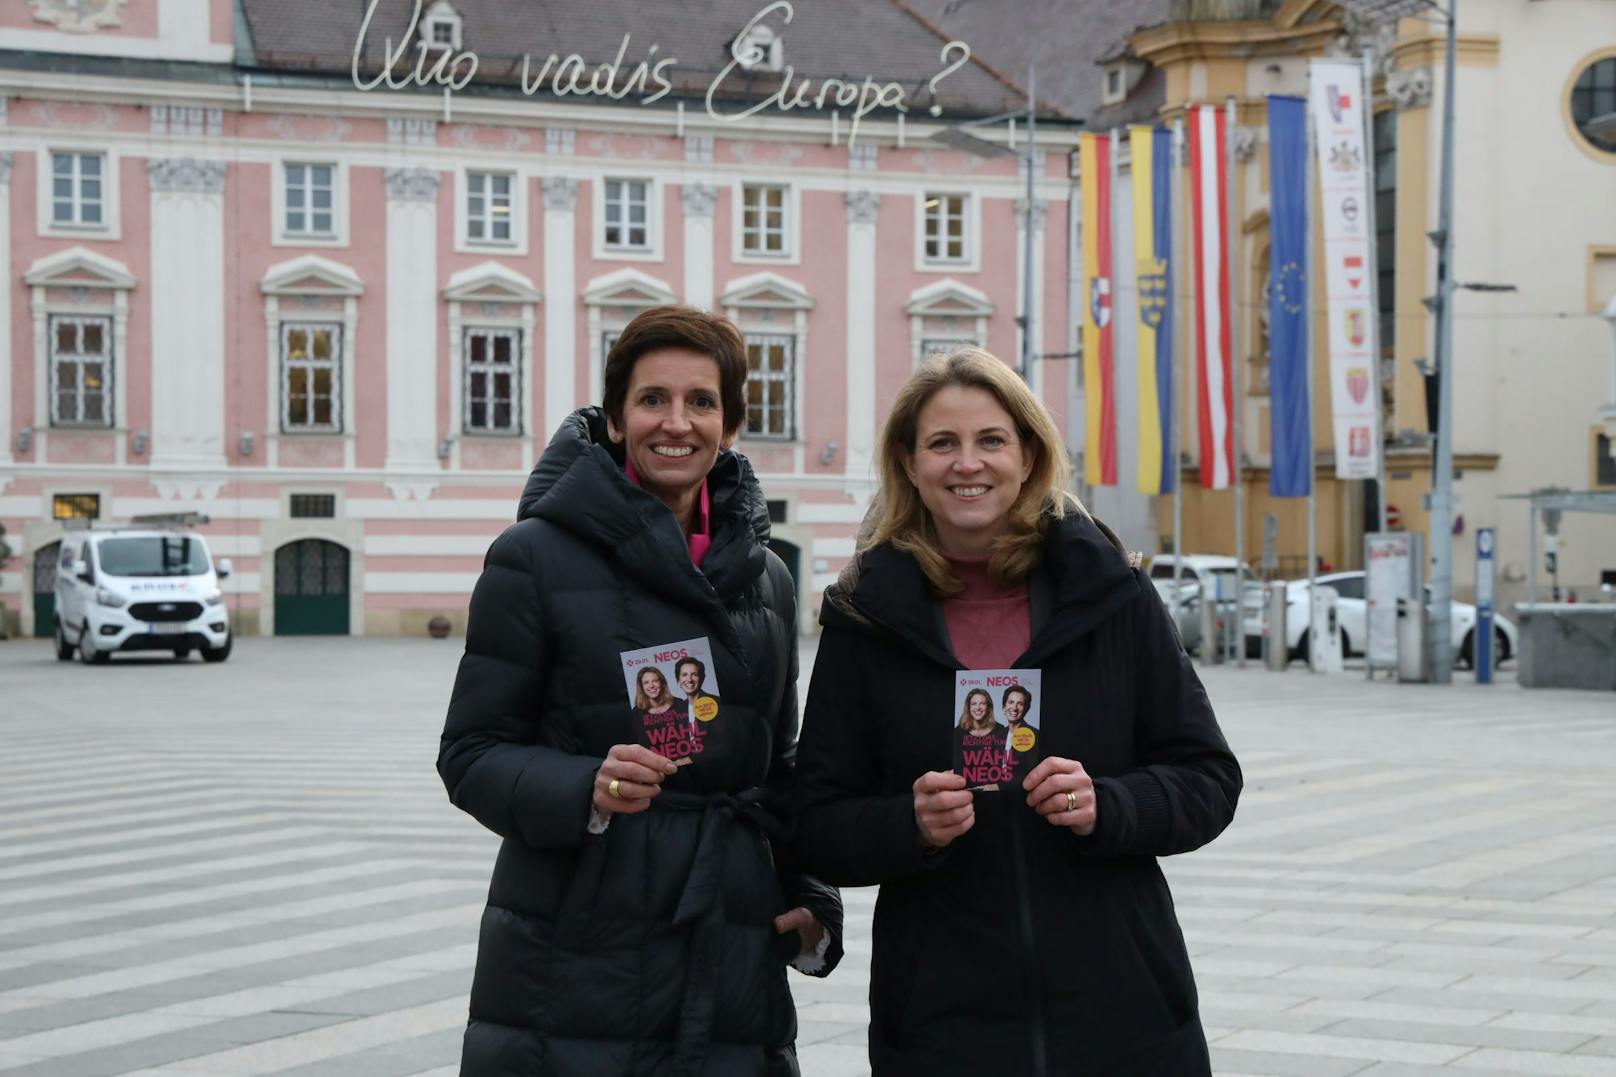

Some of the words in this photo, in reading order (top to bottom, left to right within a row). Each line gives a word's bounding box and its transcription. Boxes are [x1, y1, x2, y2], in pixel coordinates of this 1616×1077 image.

[351, 0, 479, 93] Quo
[521, 33, 678, 105] vadis
[705, 0, 972, 150] Europa?
[653, 648, 688, 664] NEOS
[986, 676, 1019, 687] NEOS
[646, 721, 708, 745] WÄHL
[962, 746, 1019, 766] WÄHL
[962, 765, 1013, 784] NEOS
